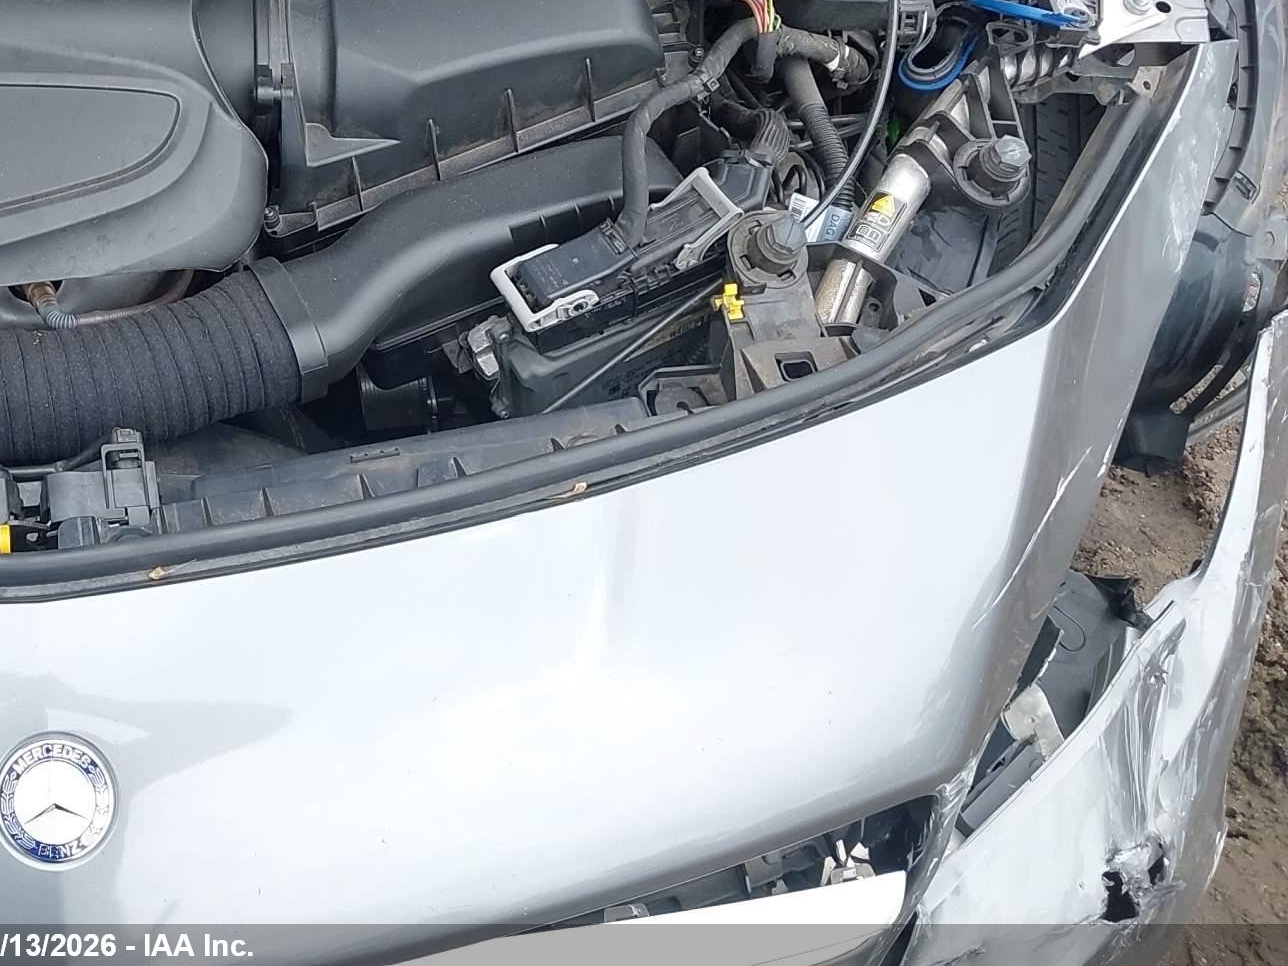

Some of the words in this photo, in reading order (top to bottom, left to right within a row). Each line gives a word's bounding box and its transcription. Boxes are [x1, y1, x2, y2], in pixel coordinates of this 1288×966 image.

[825, 213, 840, 235] DAG
[13, 744, 92, 774] MERCEDES
[37, 840, 84, 859] BENZ
